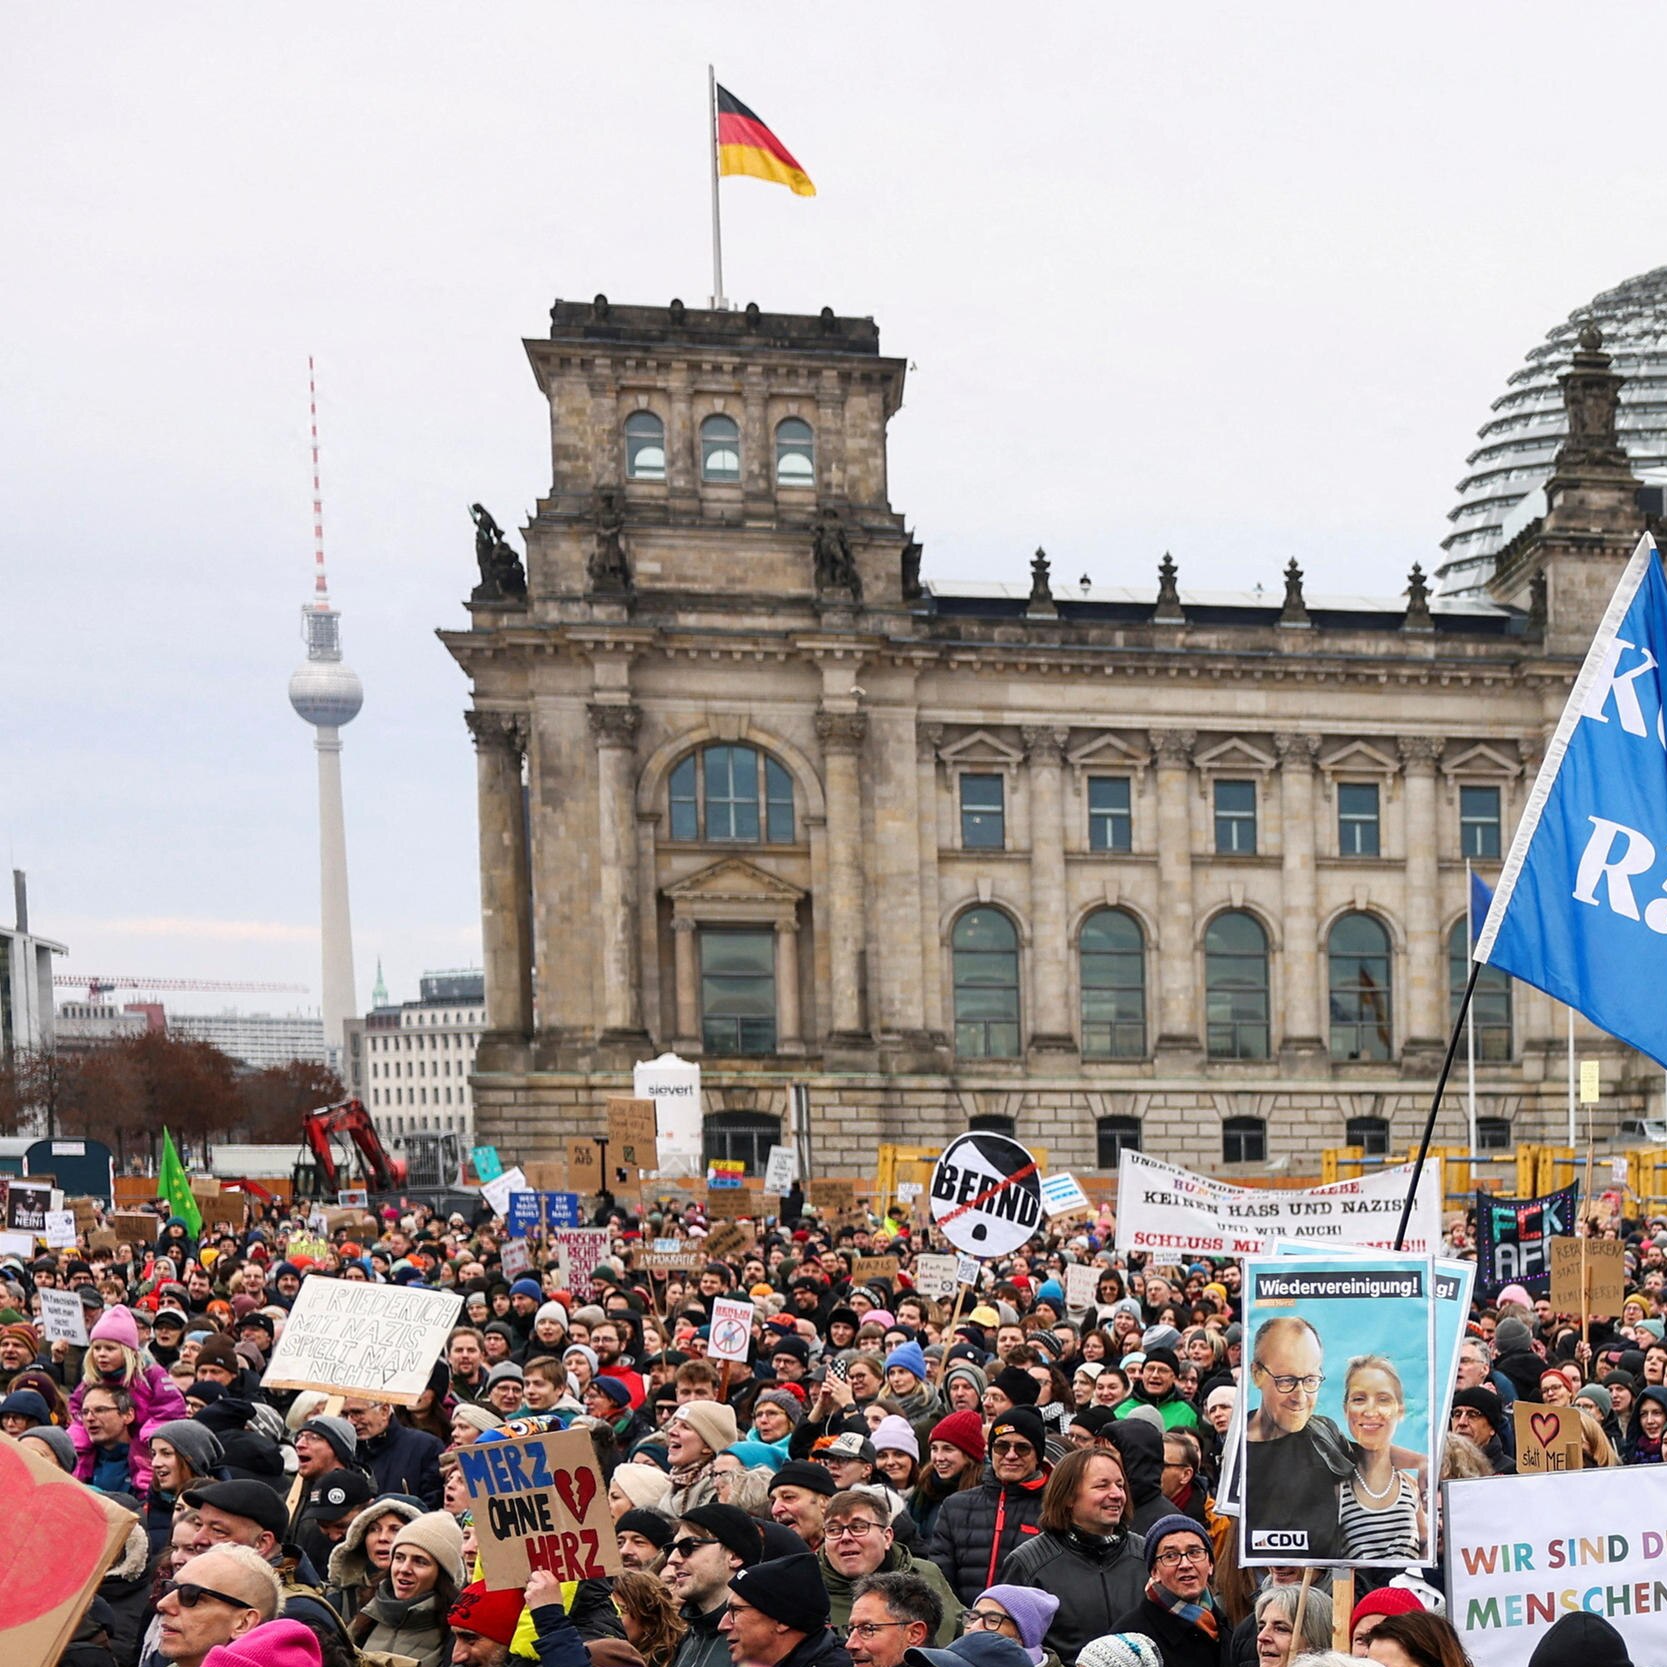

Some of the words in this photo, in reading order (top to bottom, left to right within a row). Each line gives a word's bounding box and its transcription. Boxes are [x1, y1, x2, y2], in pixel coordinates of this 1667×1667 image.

[647, 1082, 695, 1097] sievert
[931, 1162, 1040, 1229] BERND
[1142, 1191, 1219, 1217] KEINEN
[1226, 1202, 1282, 1219] HASS
[1289, 1201, 1334, 1217] UND
[1133, 1230, 1224, 1252] SCHLUSS
[1215, 1222, 1249, 1235] UND
[1253, 1224, 1292, 1237] WIR
[1295, 1224, 1342, 1237] AUCH!
[1491, 1199, 1563, 1244] FCK
[311, 1282, 457, 1328] FRIEDERICH
[1259, 1276, 1419, 1300] Wiedervereinigung!
[296, 1312, 339, 1337] MIT
[348, 1317, 427, 1351] NAZIS
[715, 1305, 751, 1318] BERLIN
[280, 1334, 358, 1368] SPIELT
[364, 1342, 422, 1375] MAN
[457, 1441, 556, 1500] MERZ
[487, 1493, 555, 1541] OHNE
[524, 1527, 607, 1583] HERZ
[1266, 1533, 1306, 1547] CDU
[1460, 1542, 1537, 1577] WIR
[1548, 1533, 1630, 1570] SIND
